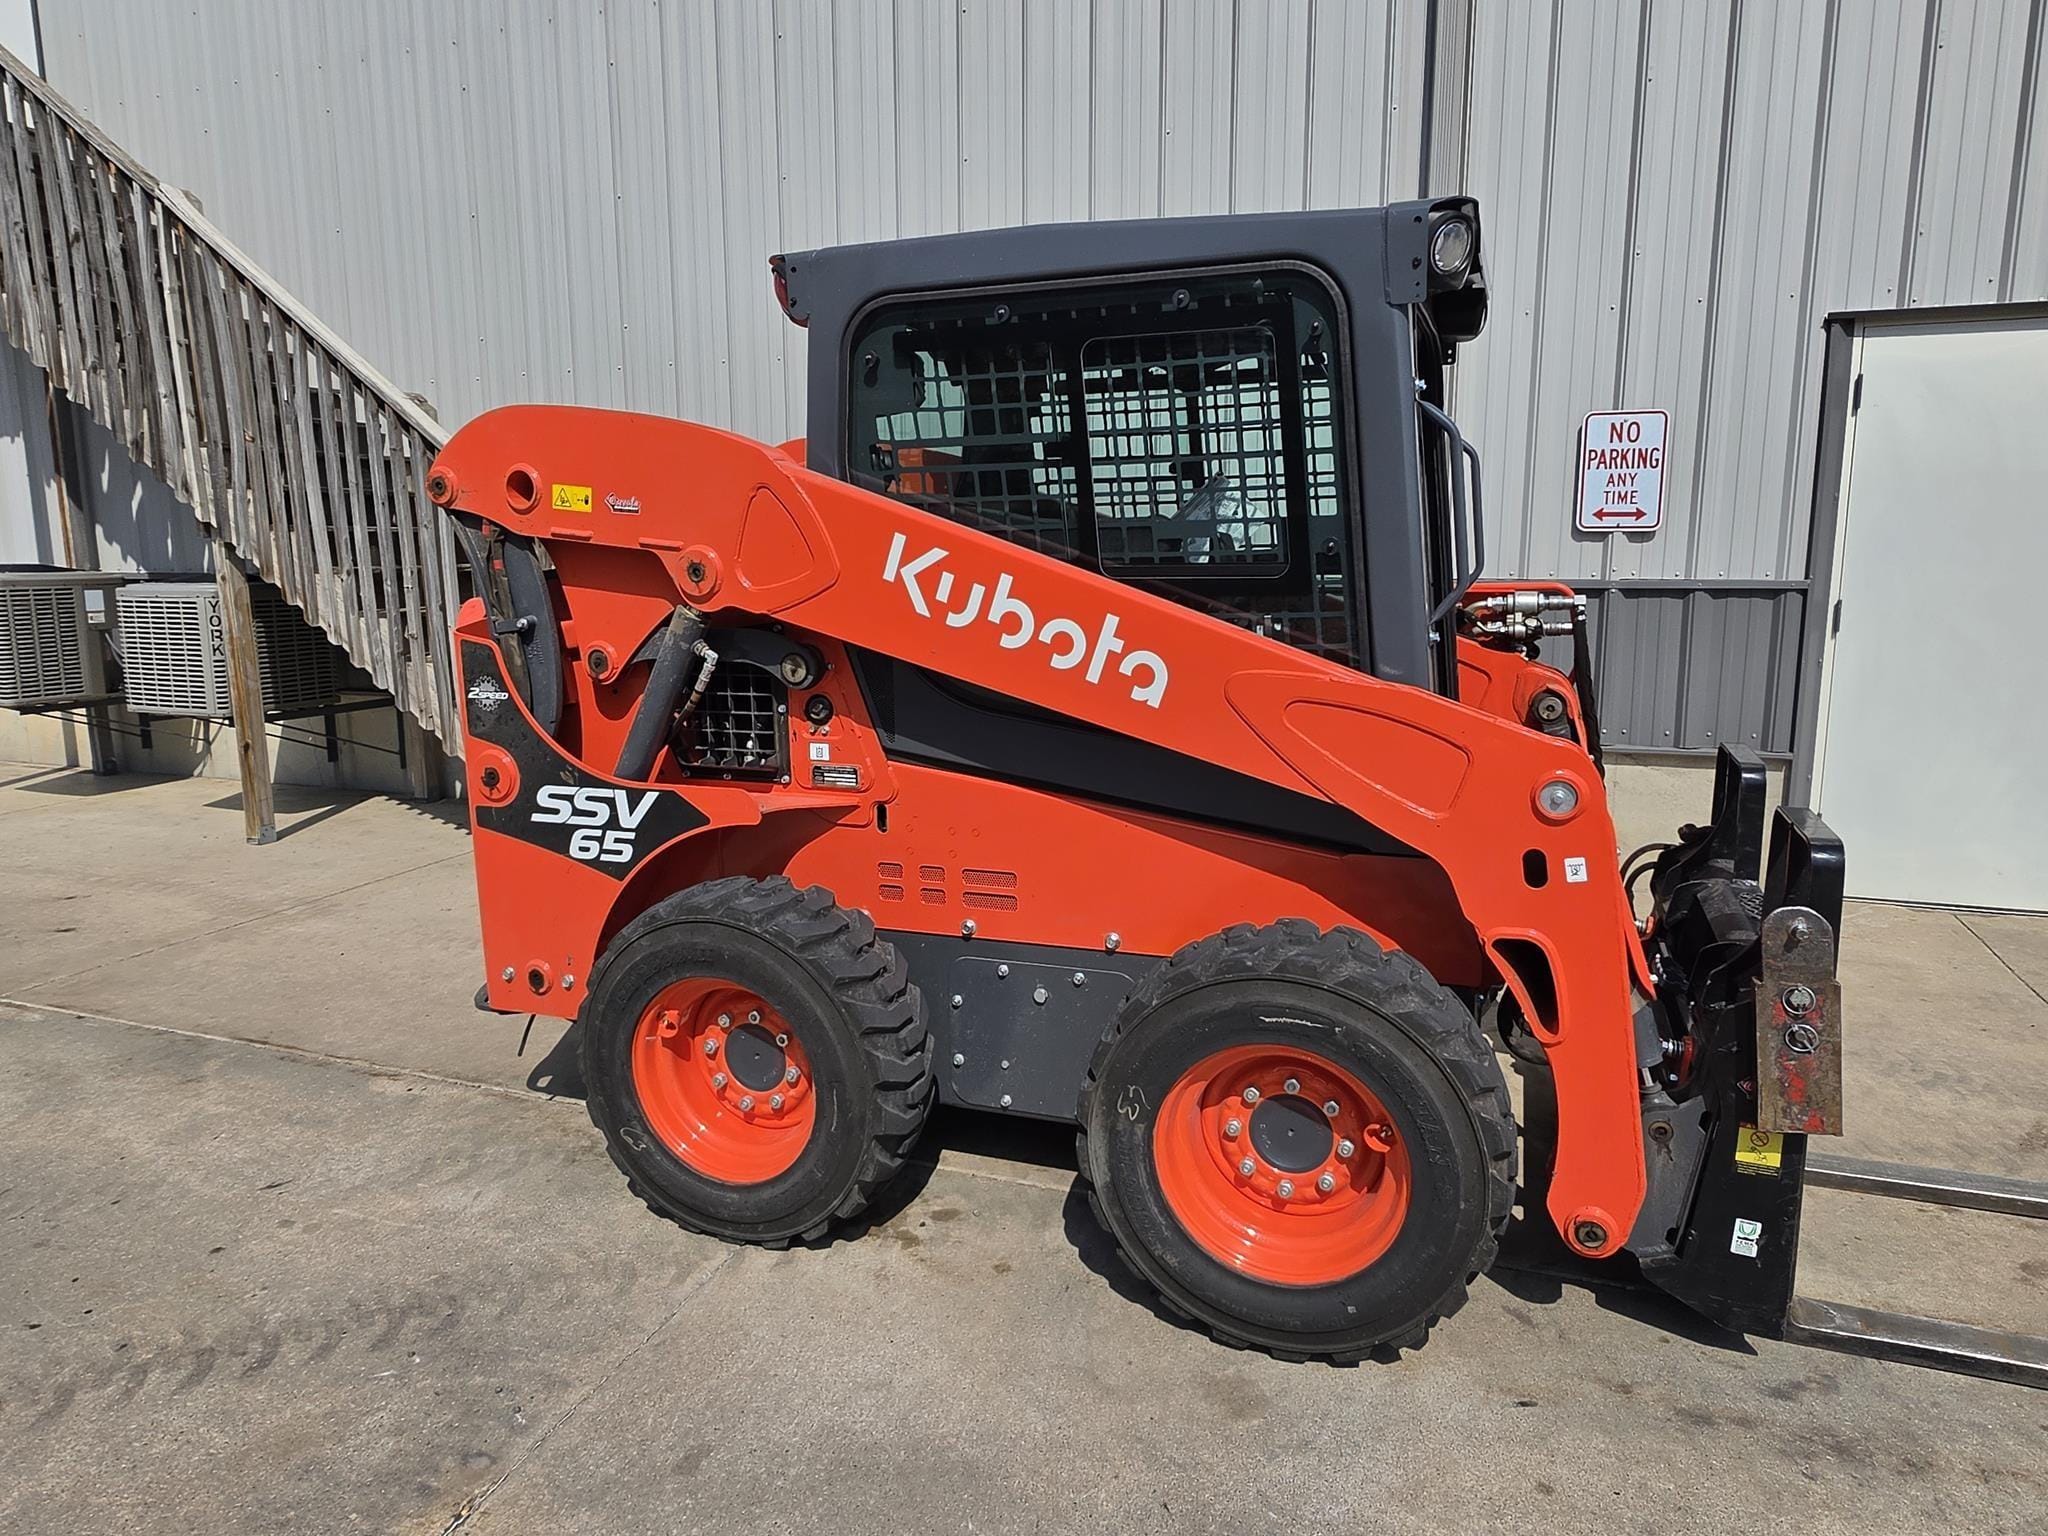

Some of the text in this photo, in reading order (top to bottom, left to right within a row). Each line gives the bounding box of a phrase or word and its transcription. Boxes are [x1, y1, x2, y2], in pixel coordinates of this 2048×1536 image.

[1609, 421, 1641, 444] NO
[1587, 447, 1660, 470] PARKING
[1605, 473, 1638, 488] ANY
[1603, 490, 1639, 505] TIME
[207, 599, 225, 657] YORK
[882, 531, 1169, 710] Kubota
[530, 784, 660, 829] SSV
[568, 828, 636, 863] 65
